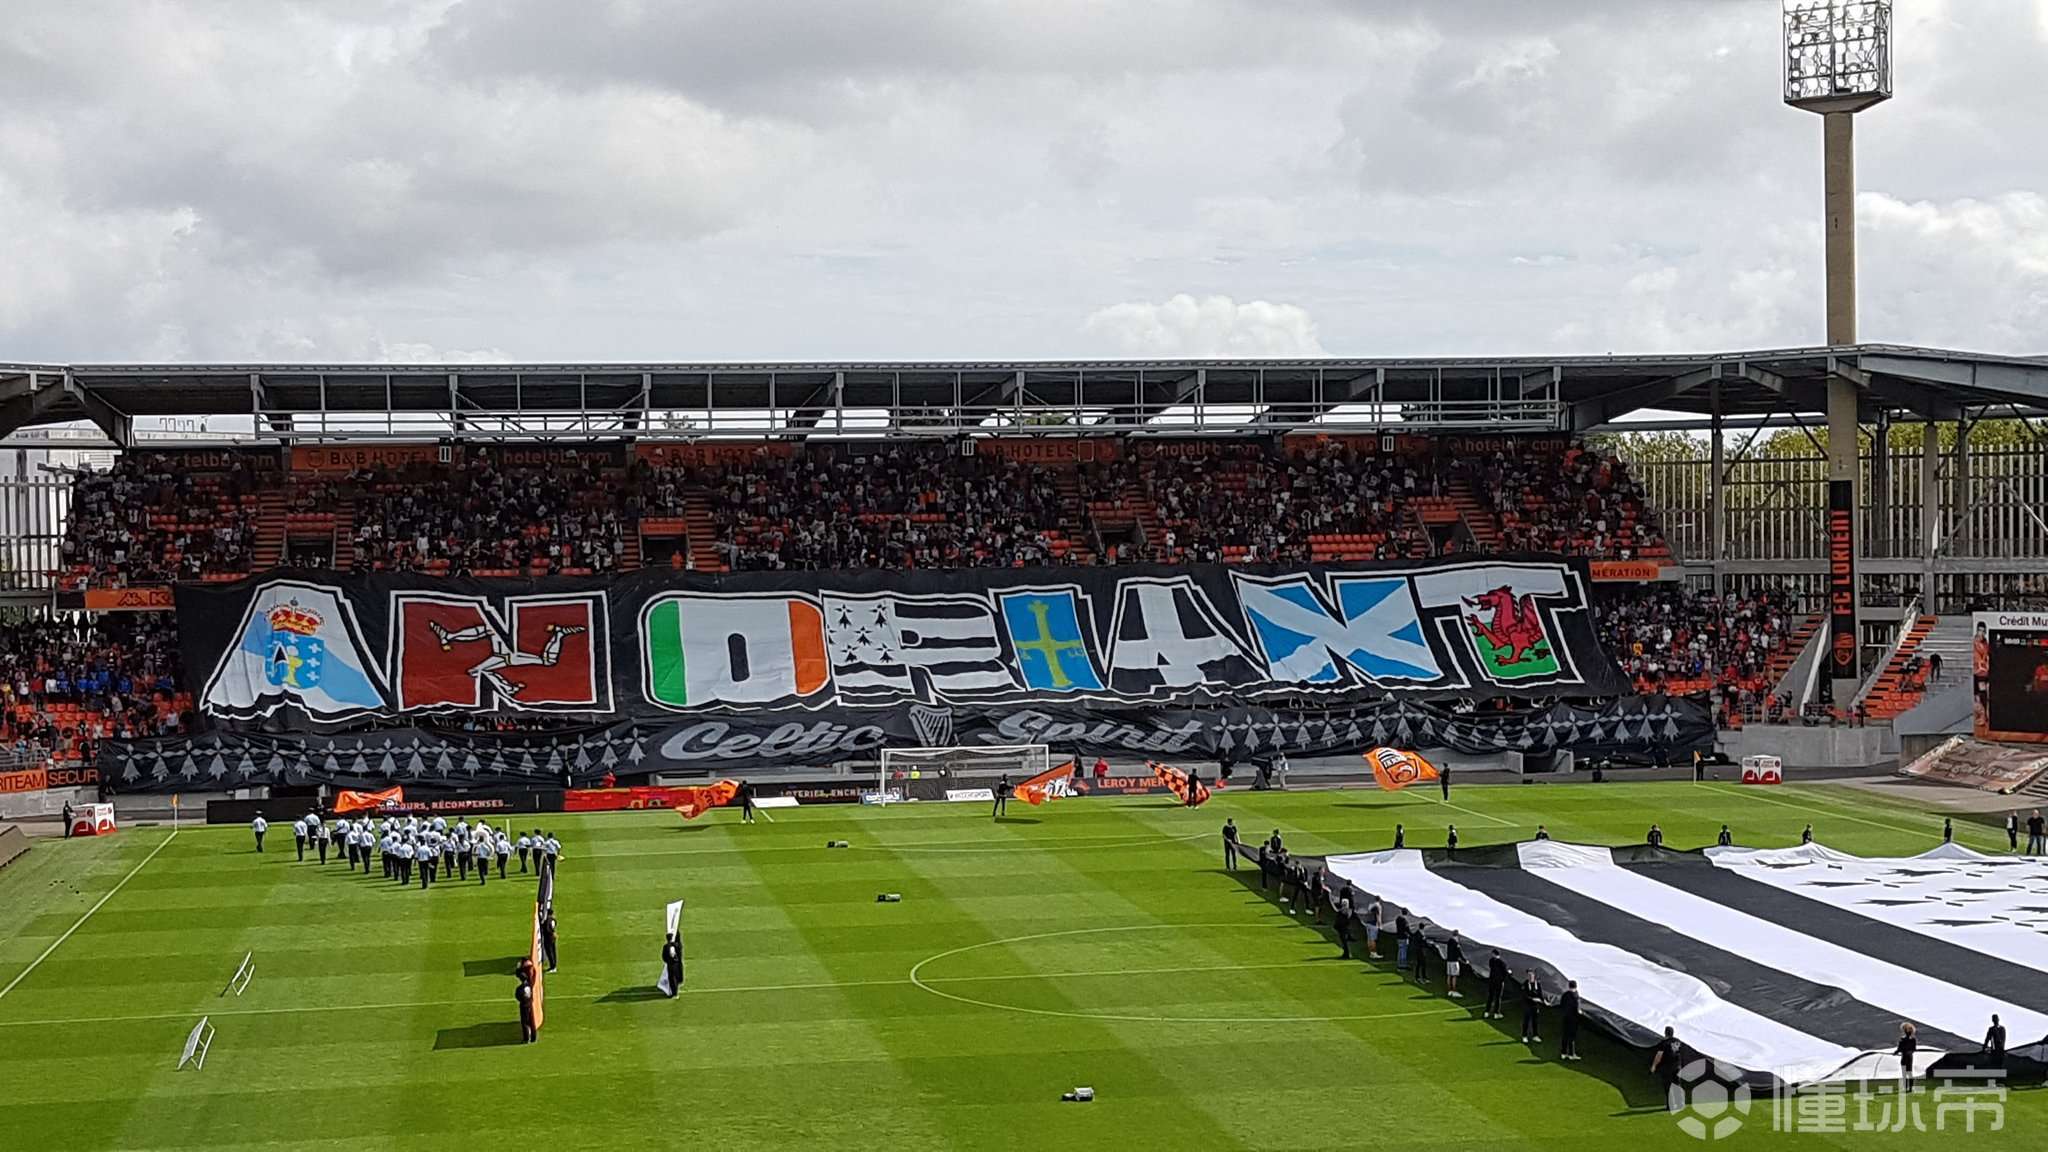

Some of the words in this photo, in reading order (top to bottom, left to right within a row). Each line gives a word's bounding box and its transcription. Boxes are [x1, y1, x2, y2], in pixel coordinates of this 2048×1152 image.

[330, 451, 366, 464] B&B
[1830, 508, 1851, 586] LORIENT
[1832, 591, 1852, 616] FC
[1999, 615, 2030, 626] Crédit
[660, 721, 886, 760] Celtic
[977, 709, 1203, 753] Spirit
[1097, 778, 1136, 788] LEROY
